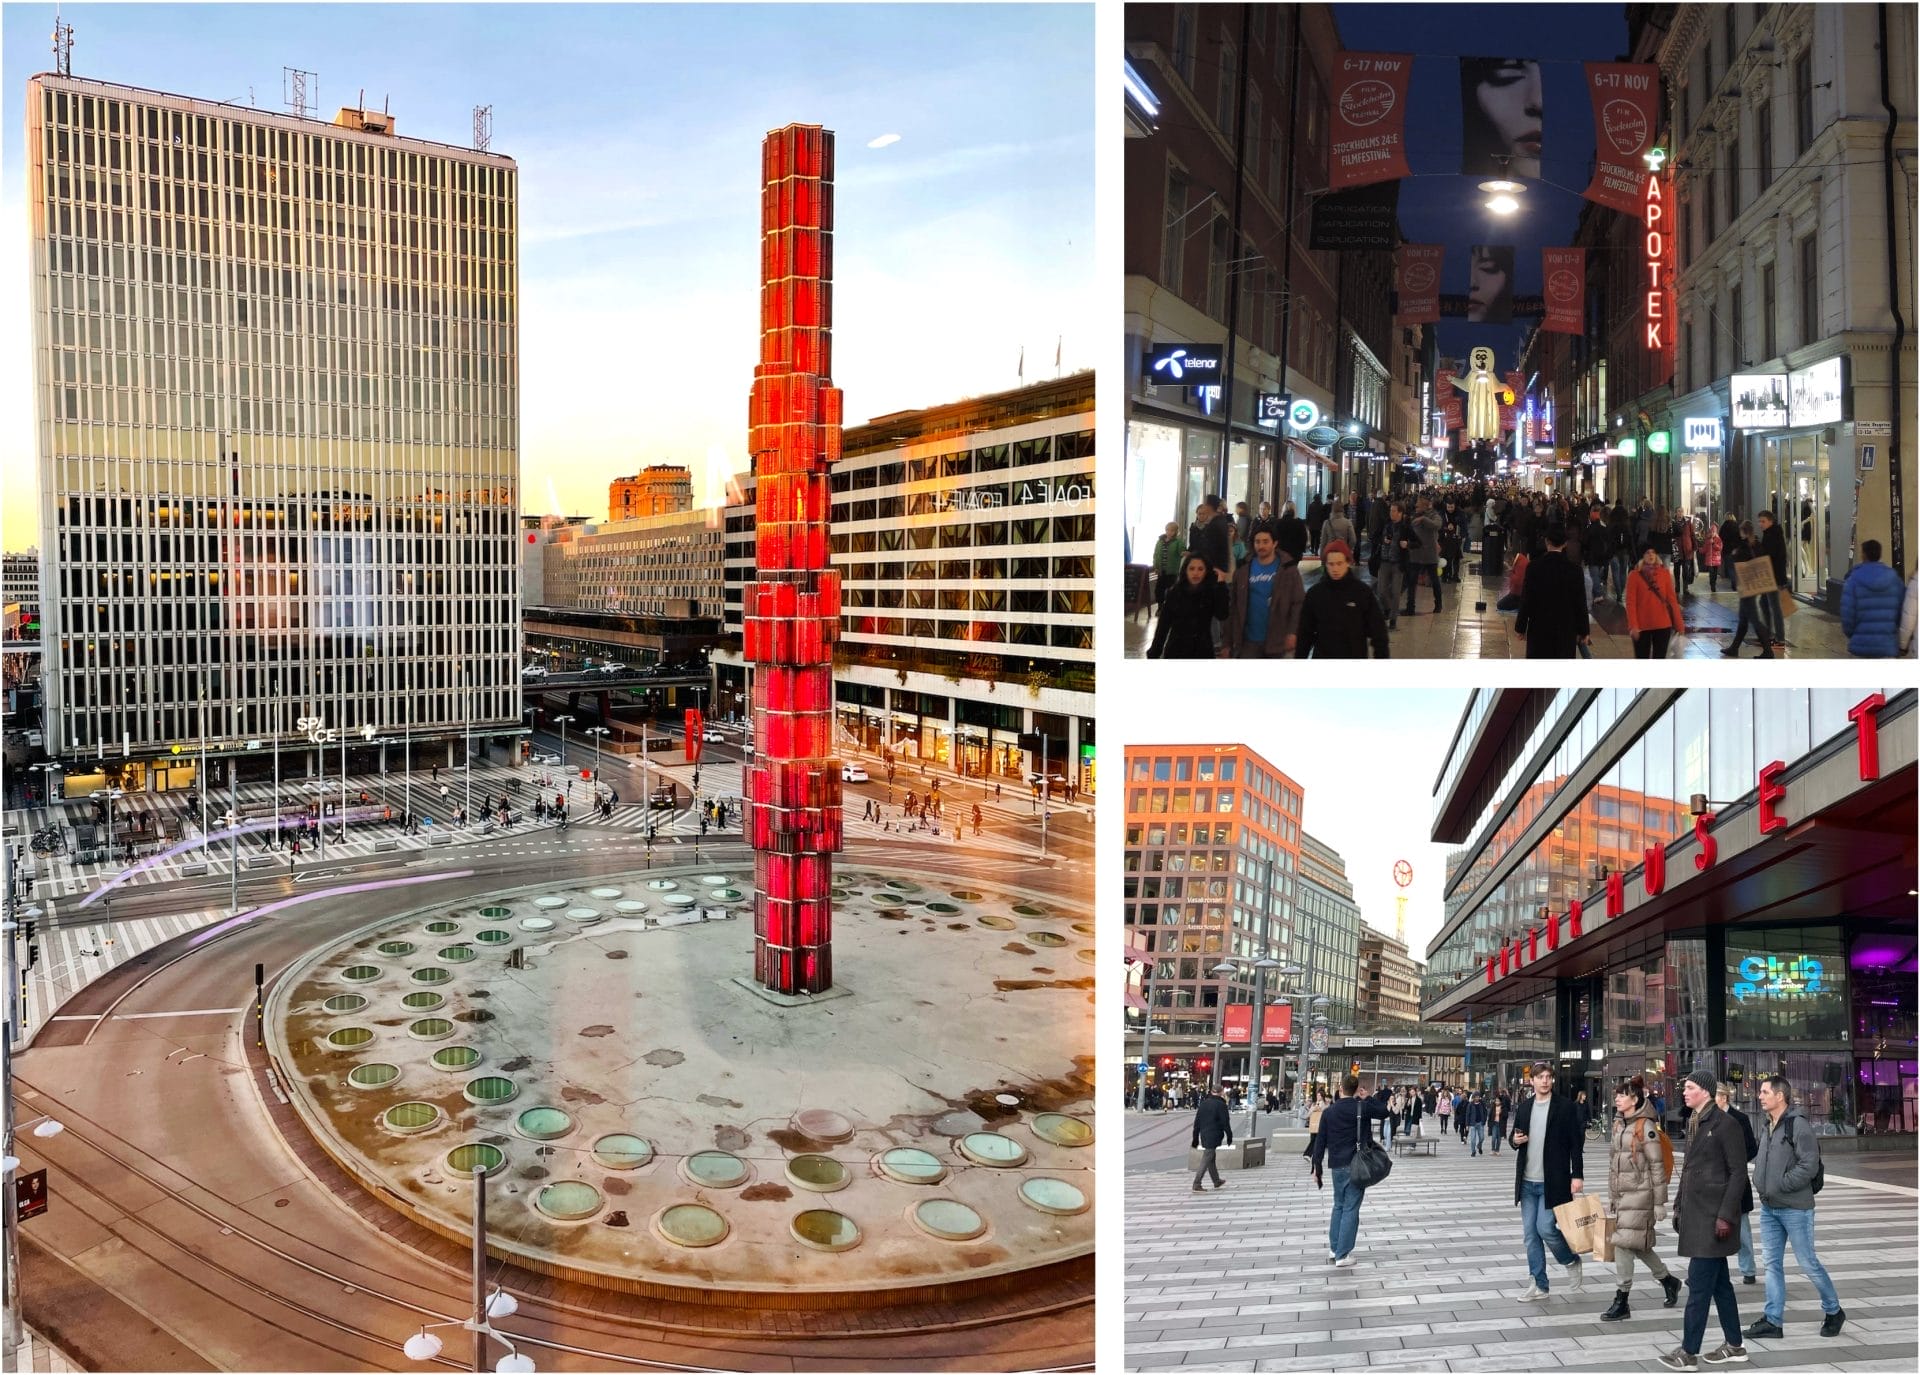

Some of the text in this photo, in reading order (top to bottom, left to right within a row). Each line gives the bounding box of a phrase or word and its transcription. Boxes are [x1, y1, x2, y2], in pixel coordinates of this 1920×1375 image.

[1374, 60, 1402, 72] NOV
[1624, 74, 1650, 91] NOV
[1332, 137, 1380, 155] STOCKHOLMS
[1341, 148, 1392, 167] FILMFESTIVAL
[1646, 175, 1663, 349] APOTEK
[1184, 357, 1218, 369] telenor
[1265, 397, 1288, 407] Silver
[1267, 407, 1285, 418] City
[1739, 954, 1823, 981] Club
[1763, 982, 1805, 990] december
